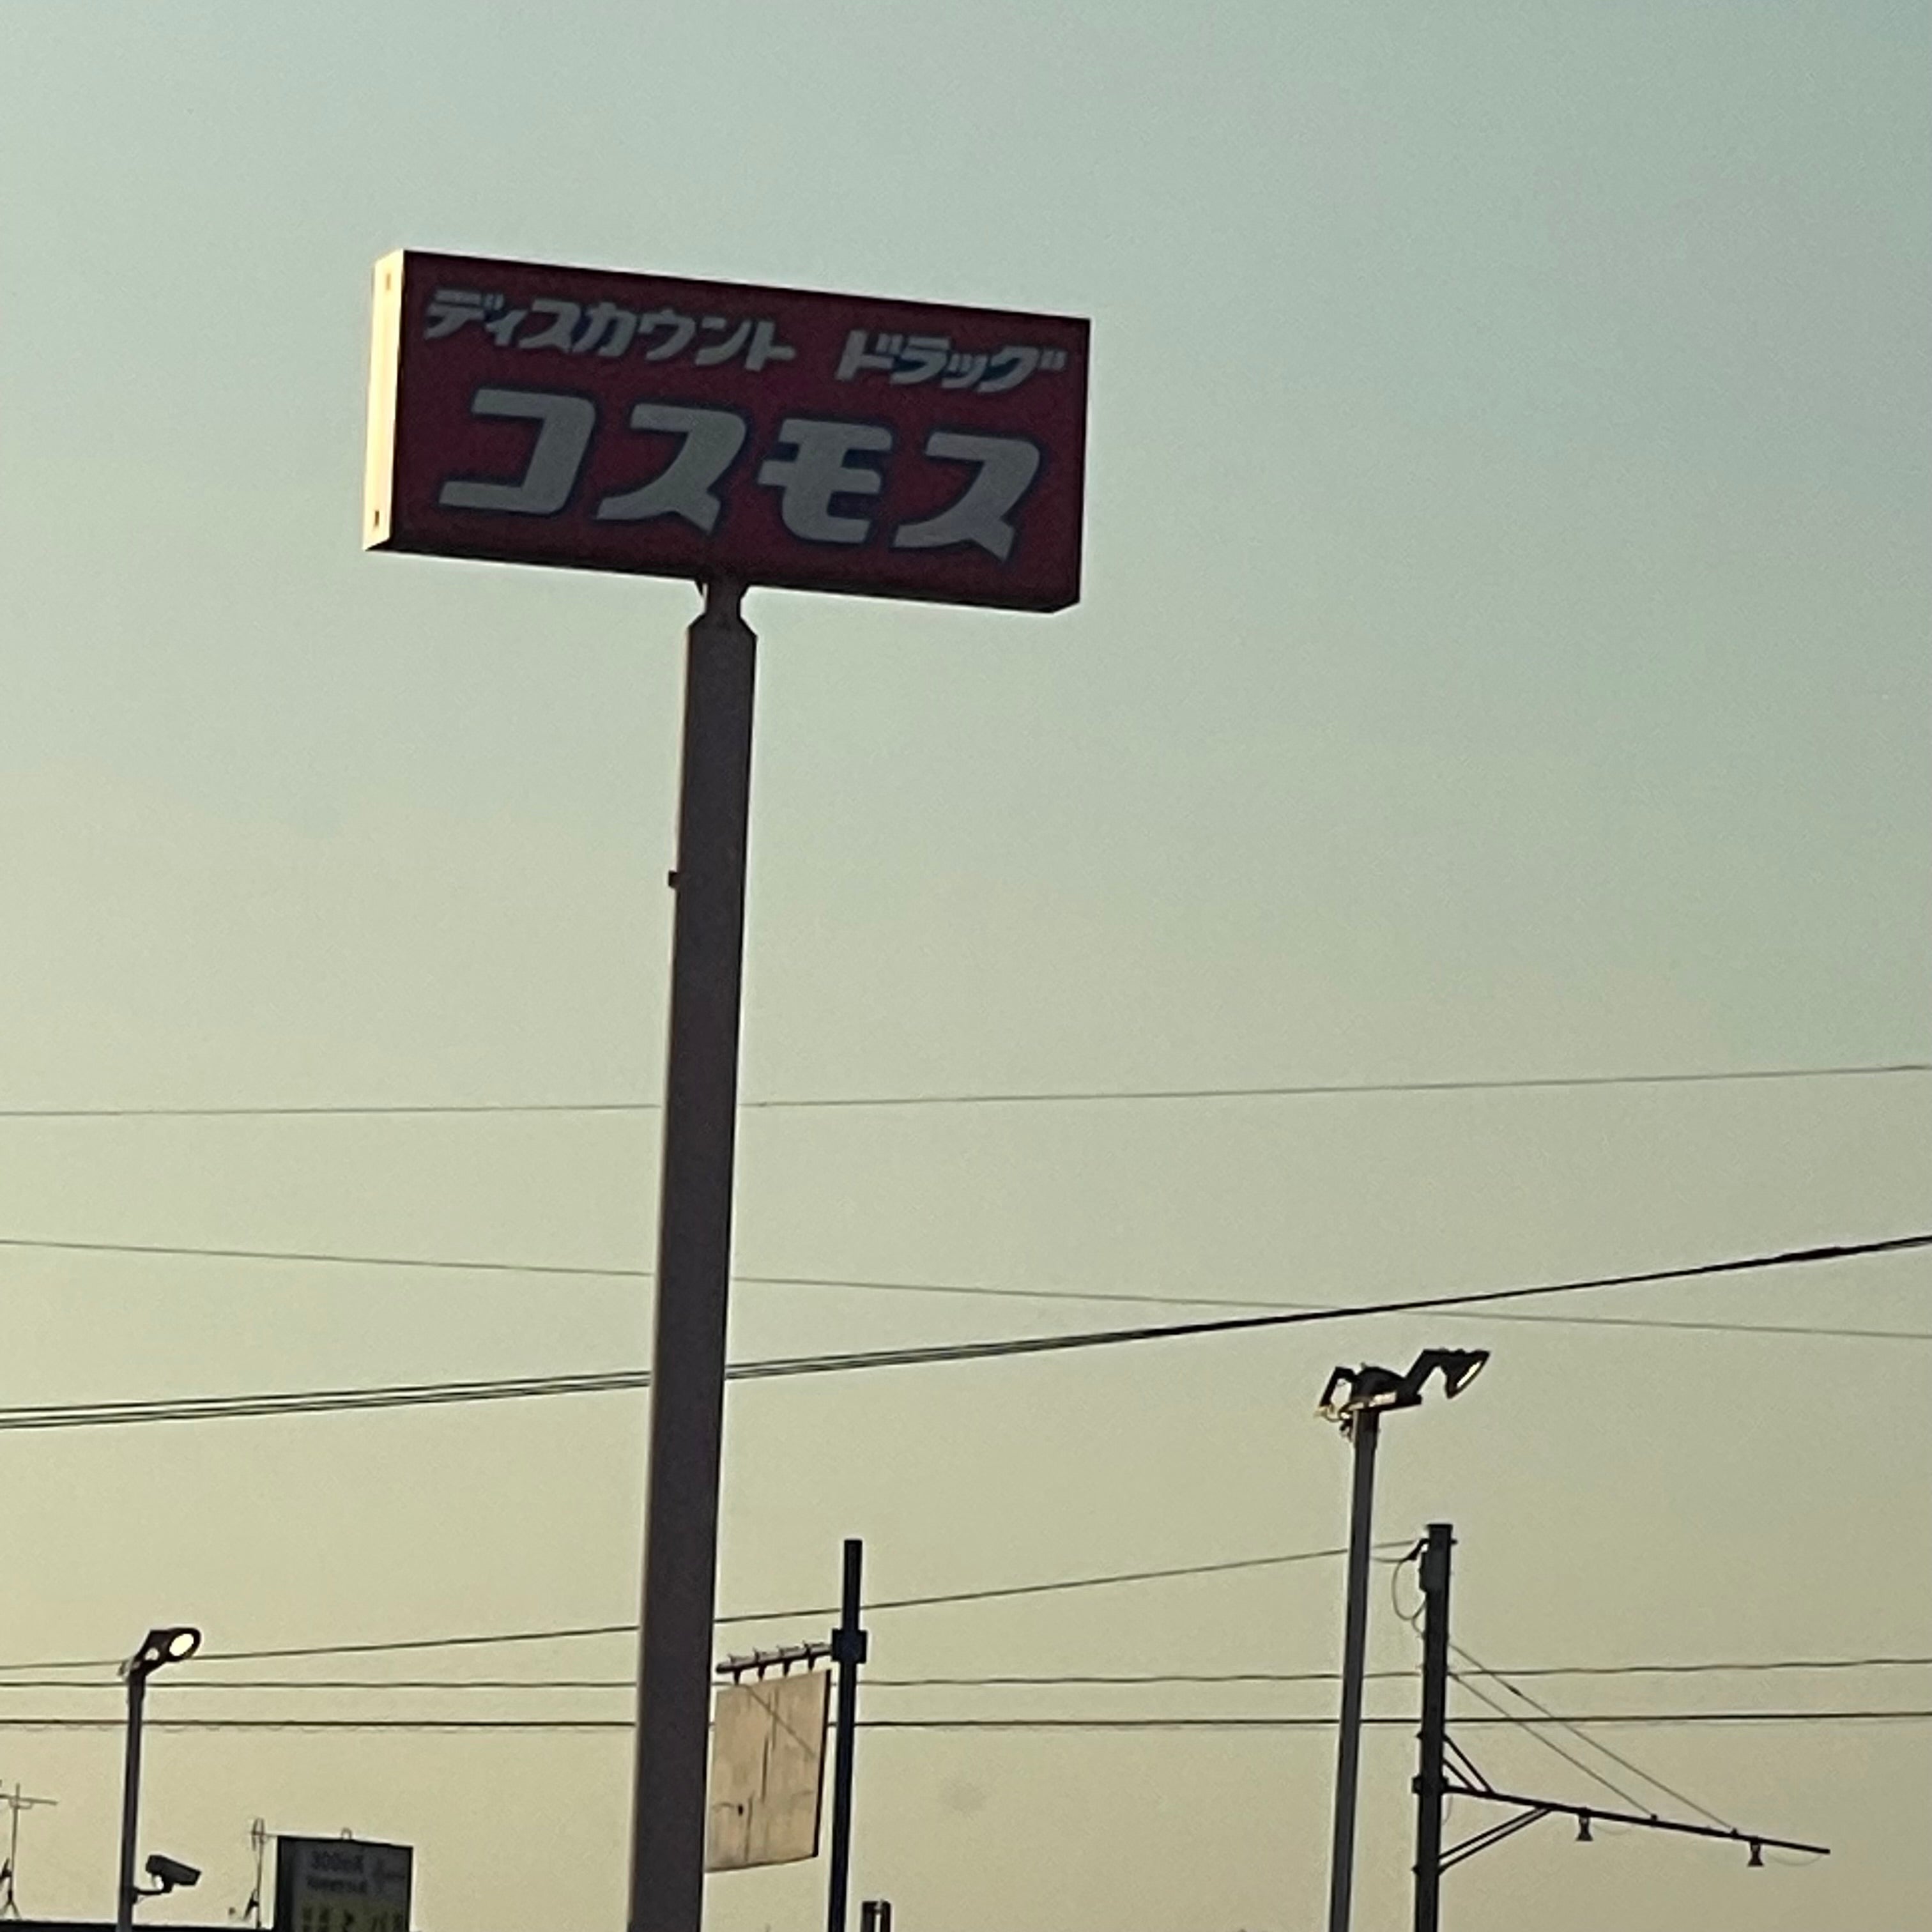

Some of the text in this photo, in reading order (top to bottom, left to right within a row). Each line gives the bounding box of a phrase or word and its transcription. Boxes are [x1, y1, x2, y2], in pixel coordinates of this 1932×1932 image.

[424, 289, 1066, 393] ディスカウント ドラッグ
[438, 388, 1041, 562] コスモス
